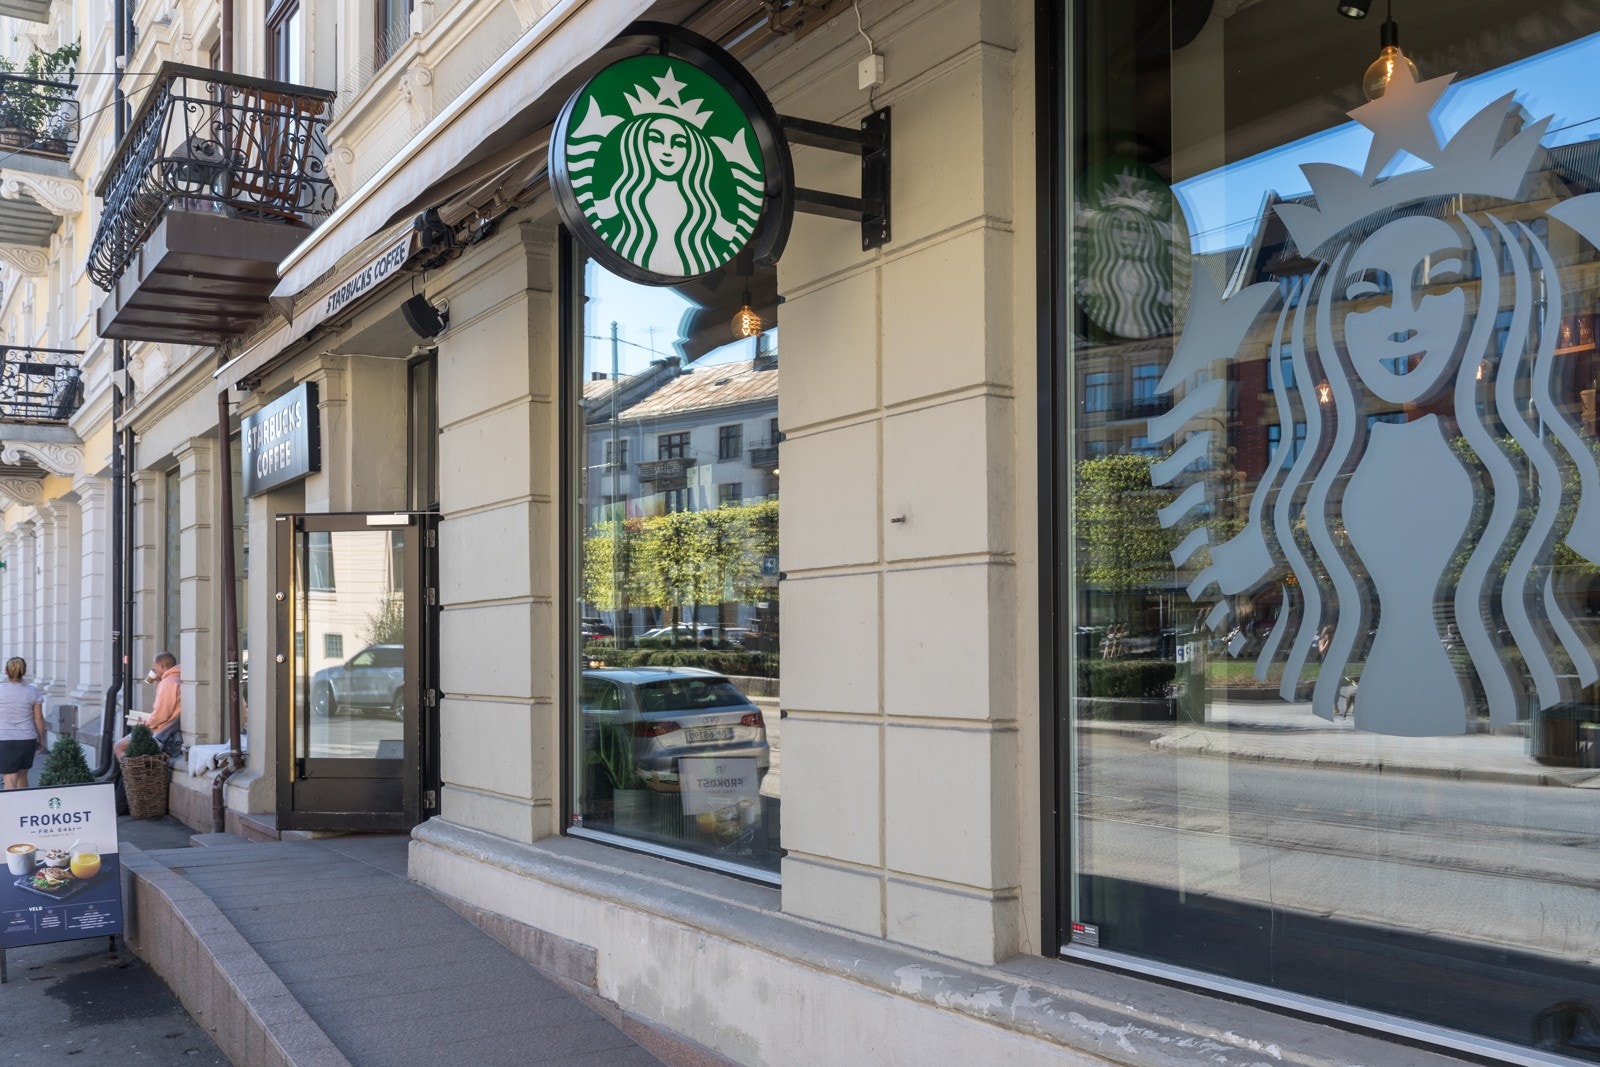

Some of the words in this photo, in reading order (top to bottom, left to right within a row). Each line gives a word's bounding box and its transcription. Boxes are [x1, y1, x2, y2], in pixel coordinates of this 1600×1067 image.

[326, 266, 372, 314] STARBUCKS
[374, 240, 406, 281] COFFEE
[247, 400, 302, 453] STARBUCKS
[256, 440, 291, 479] COFFEE
[20, 811, 91, 828] FROKOST
